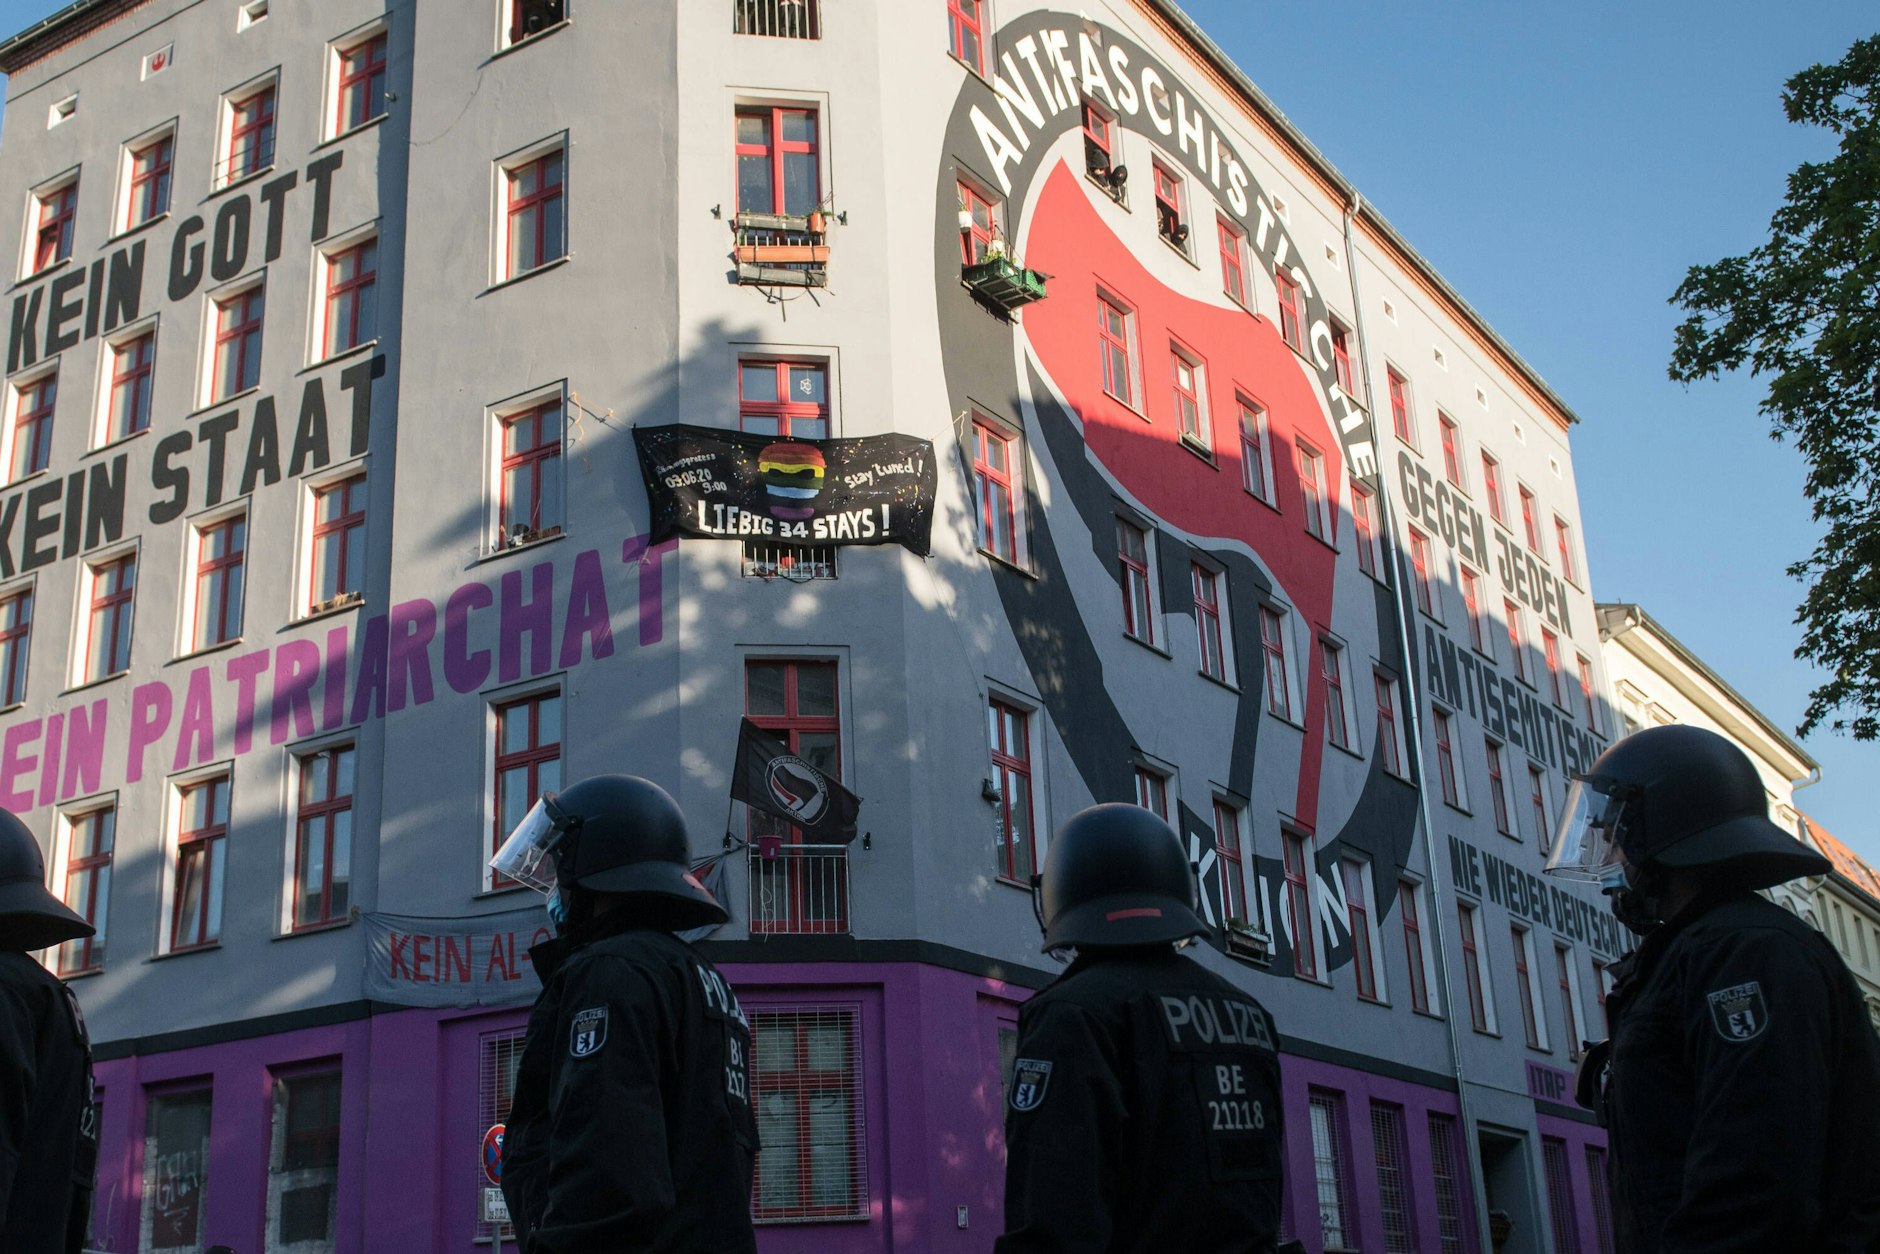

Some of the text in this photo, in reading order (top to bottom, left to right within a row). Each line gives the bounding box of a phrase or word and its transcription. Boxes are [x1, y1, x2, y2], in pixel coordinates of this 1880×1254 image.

[6, 149, 344, 375] KEIN GOTT
[148, 354, 386, 525] STAAT
[701, 481, 728, 495] 9:00
[697, 499, 774, 535] LIEBIG
[779, 520, 809, 539] 34
[1398, 450, 1573, 640] GEGEN JEDEN
[125, 533, 680, 784] PATRIARCHAT
[1448, 834, 1483, 896] NIE
[1482, 850, 1552, 928] WIEDER
[388, 932, 472, 984] KEIN
[1159, 995, 1275, 1051] POLIZEI
[1215, 1064, 1247, 1095] BE
[1208, 1099, 1265, 1131] 21218
